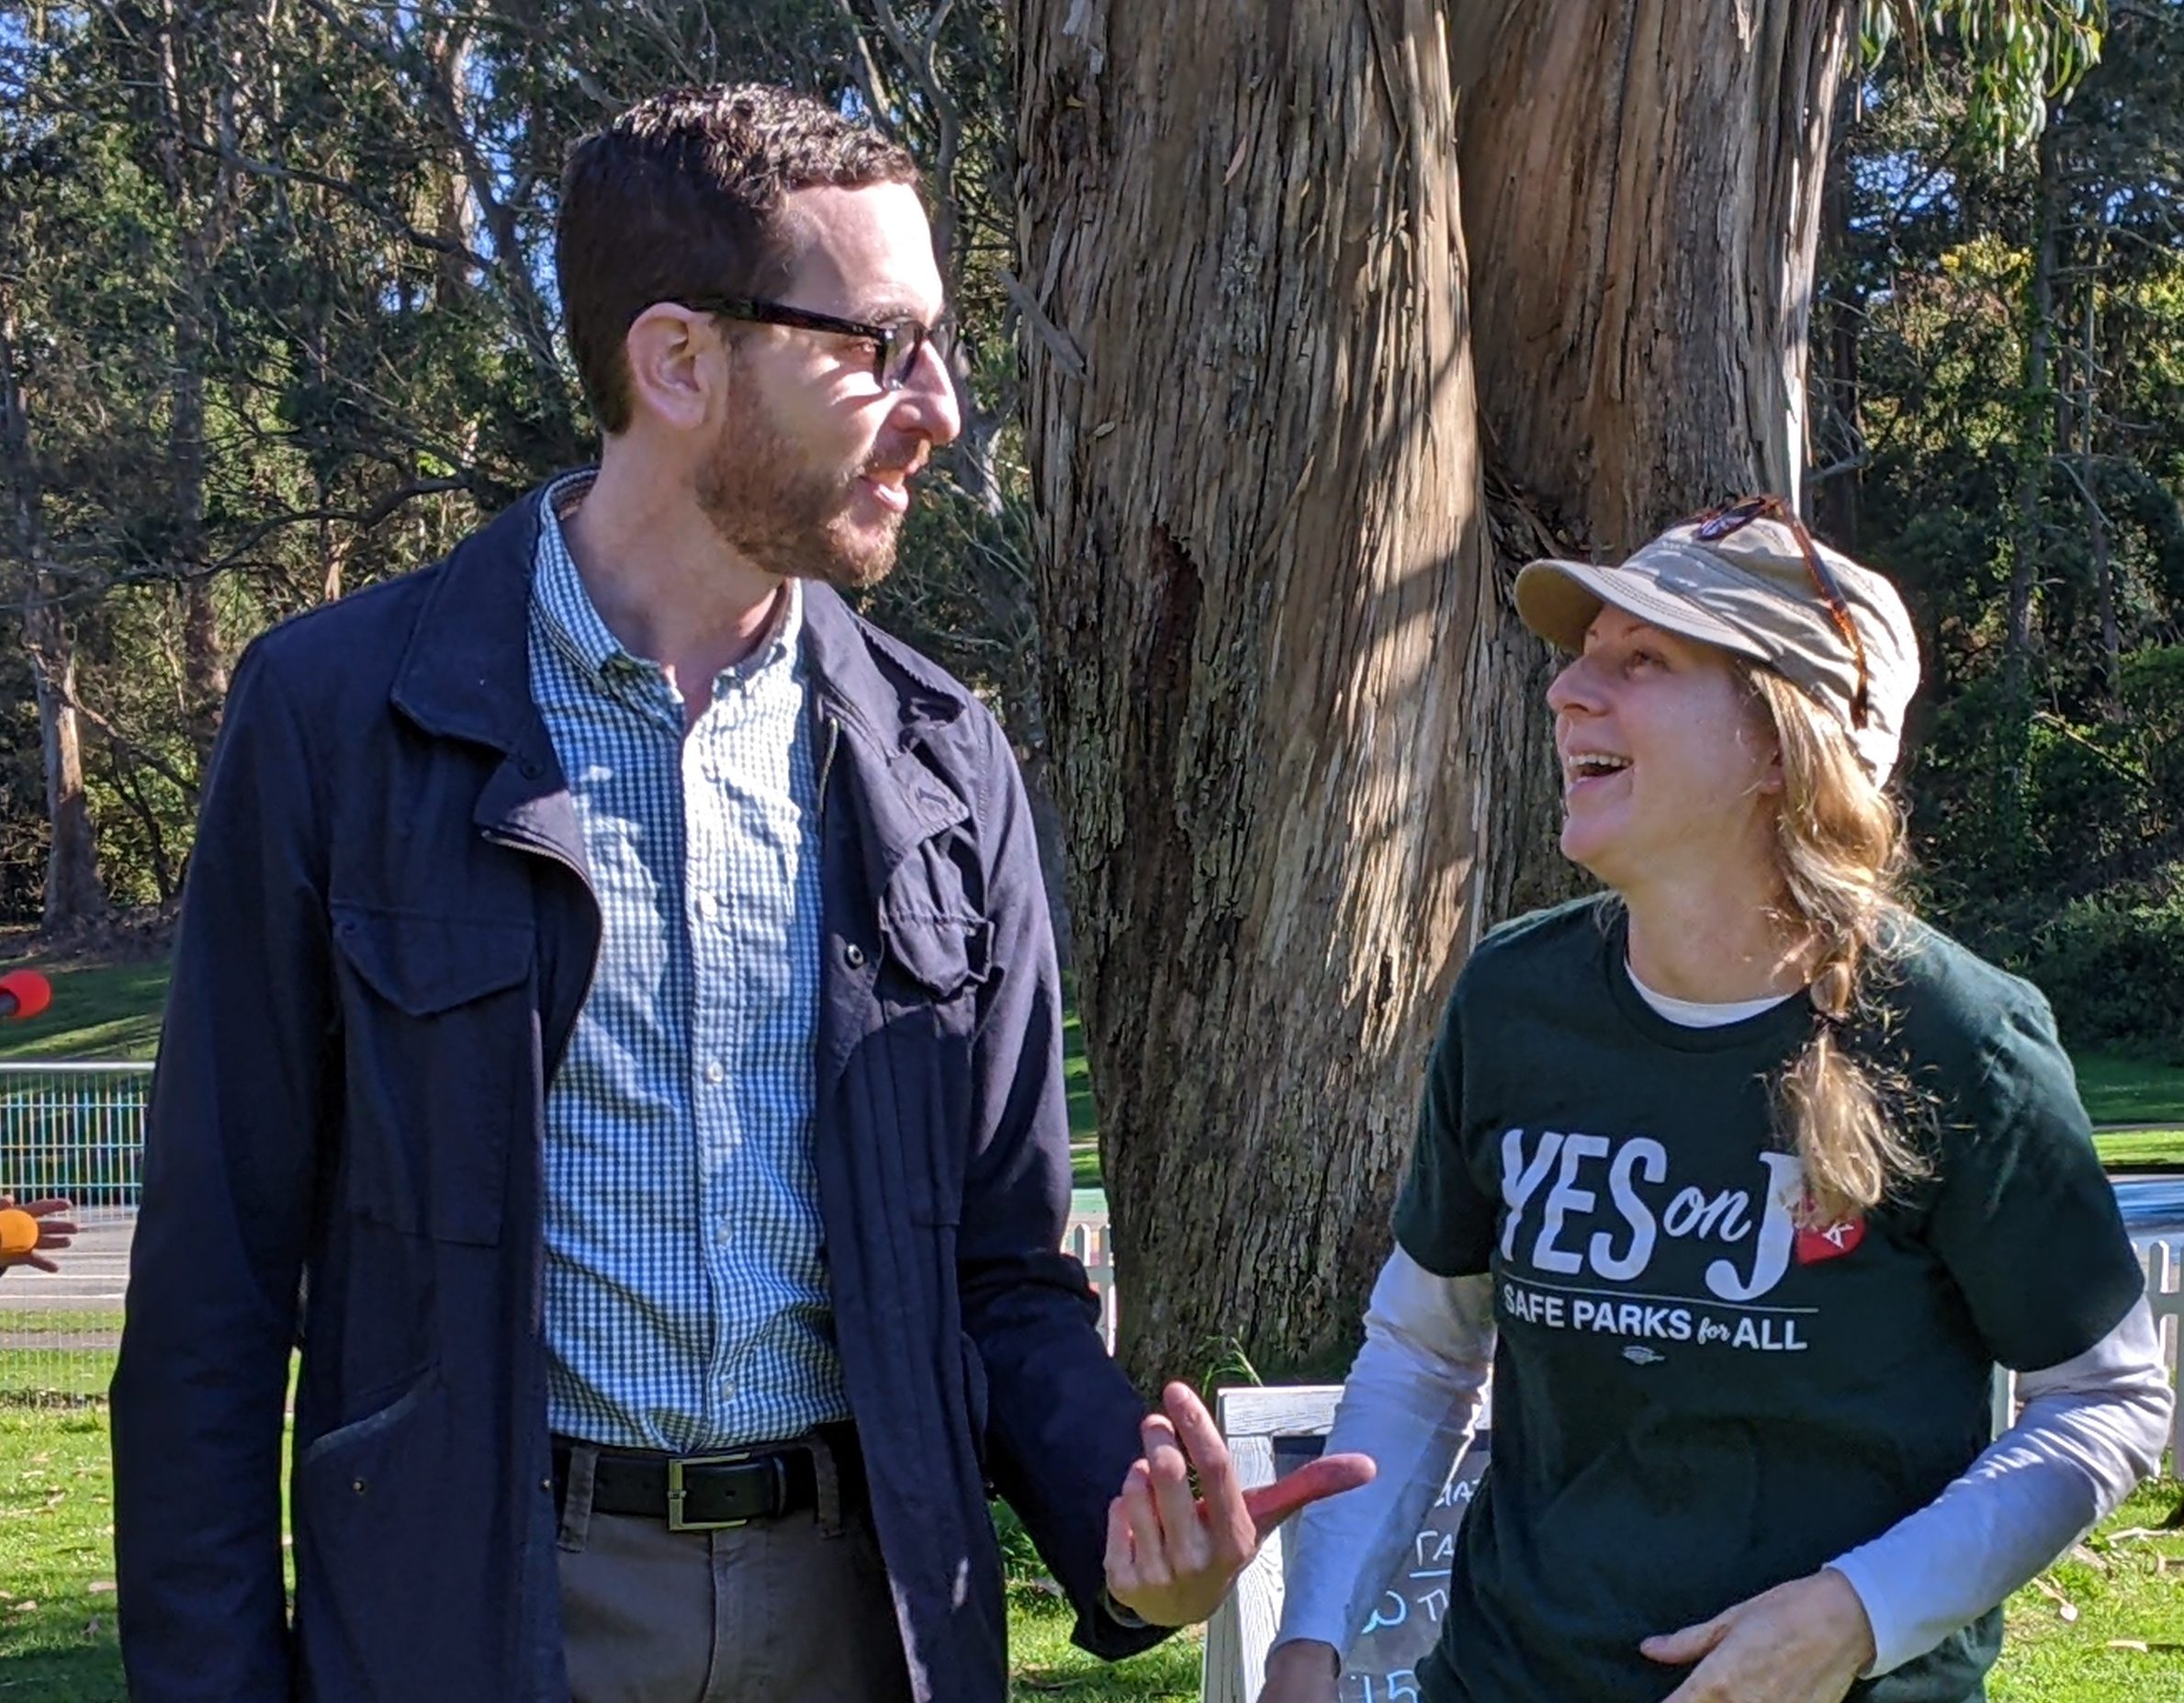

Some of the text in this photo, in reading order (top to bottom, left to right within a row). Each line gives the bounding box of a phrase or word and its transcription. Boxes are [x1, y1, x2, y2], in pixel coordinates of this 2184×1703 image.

[1501, 1128, 1806, 1302] YES on J
[1503, 1283, 1808, 1350] SAFE PARKS for ALL
